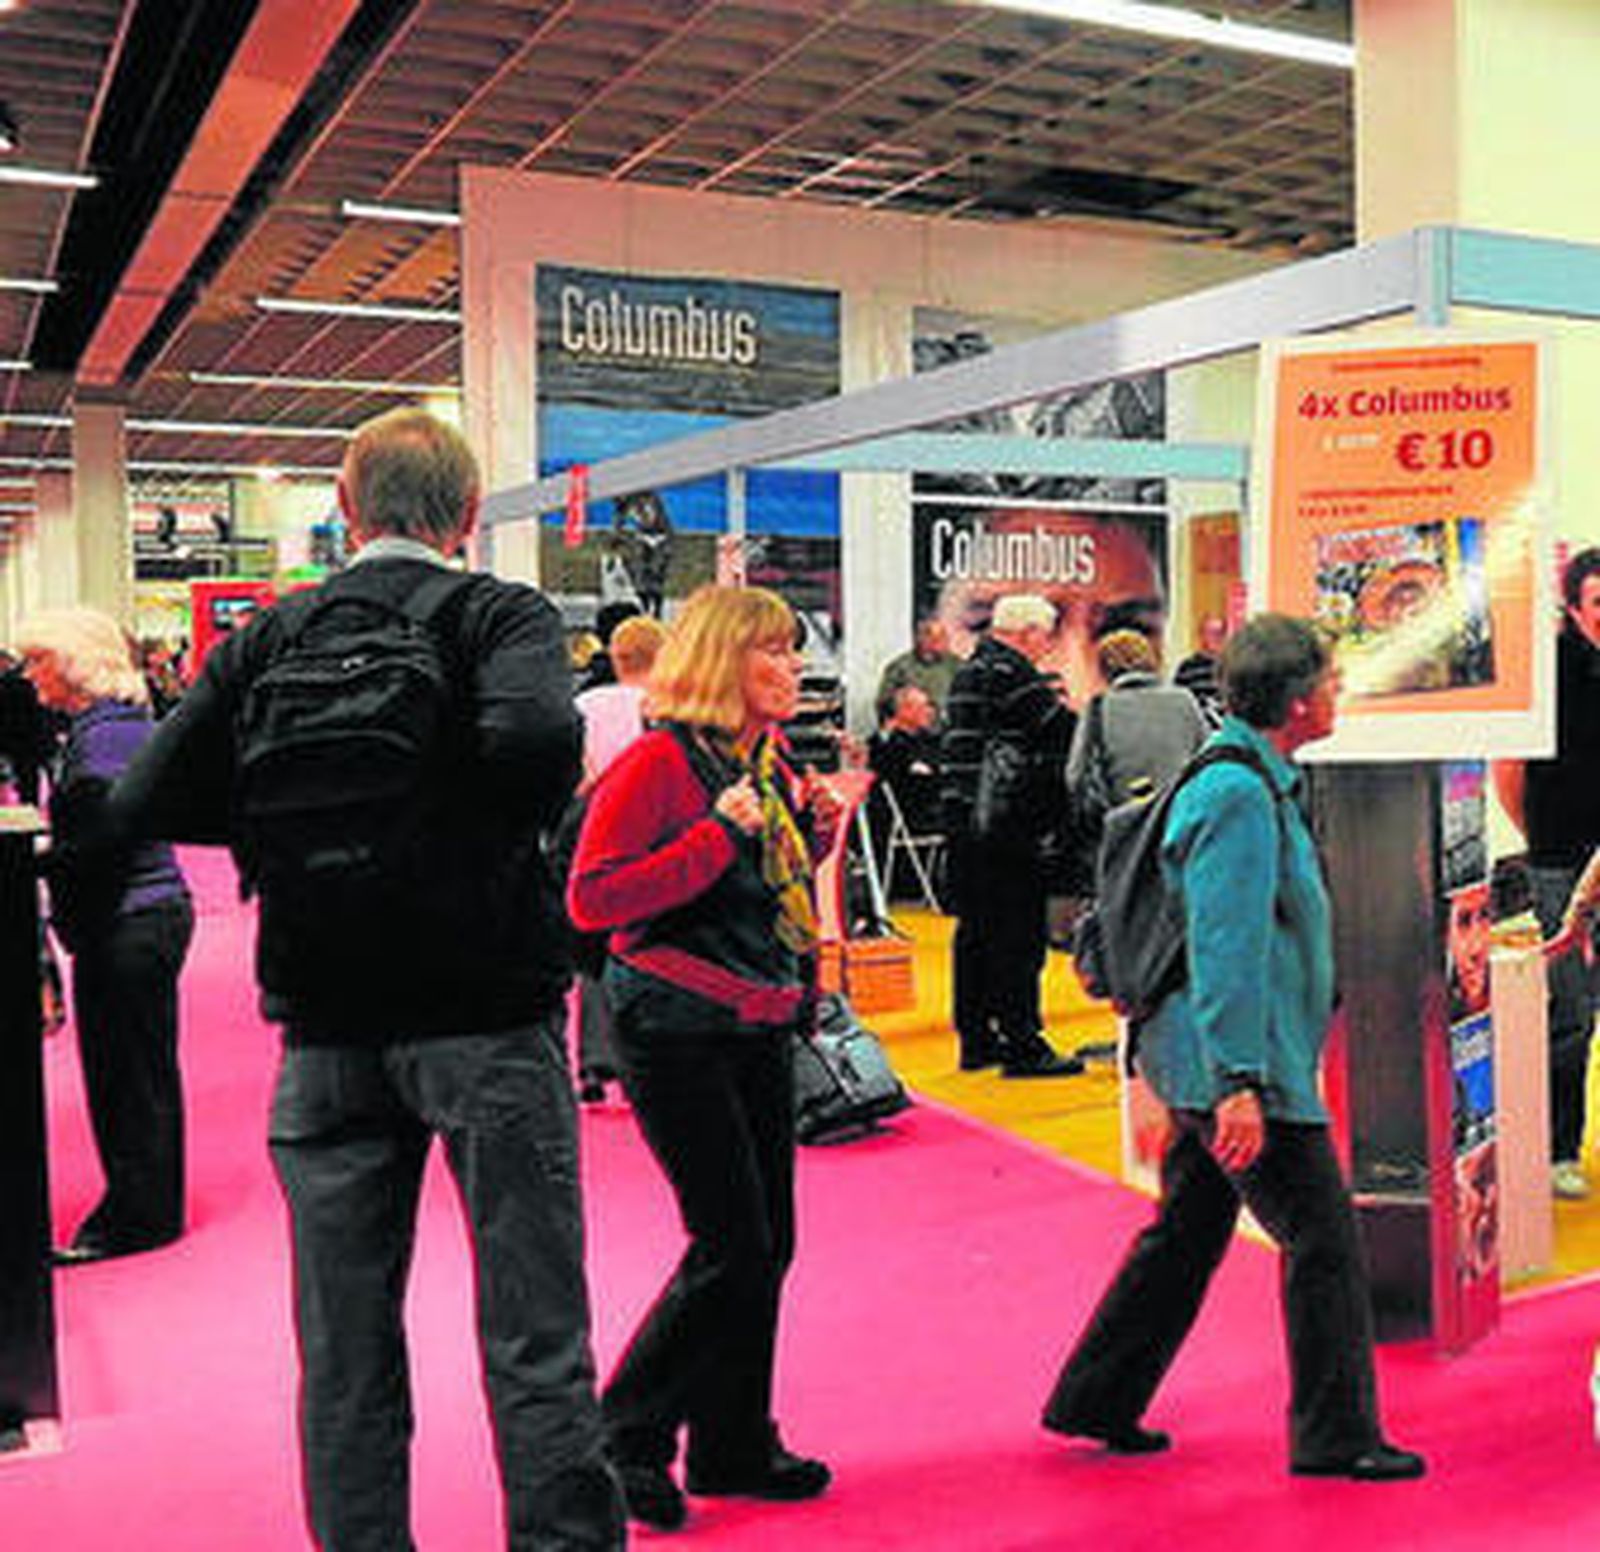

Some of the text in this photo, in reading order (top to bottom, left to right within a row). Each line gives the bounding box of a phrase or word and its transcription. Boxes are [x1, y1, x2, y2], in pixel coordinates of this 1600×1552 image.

[561, 285, 756, 364] Columbus
[1298, 384, 1511, 418] 4x Columbus
[931, 518, 1096, 584] Columbus
